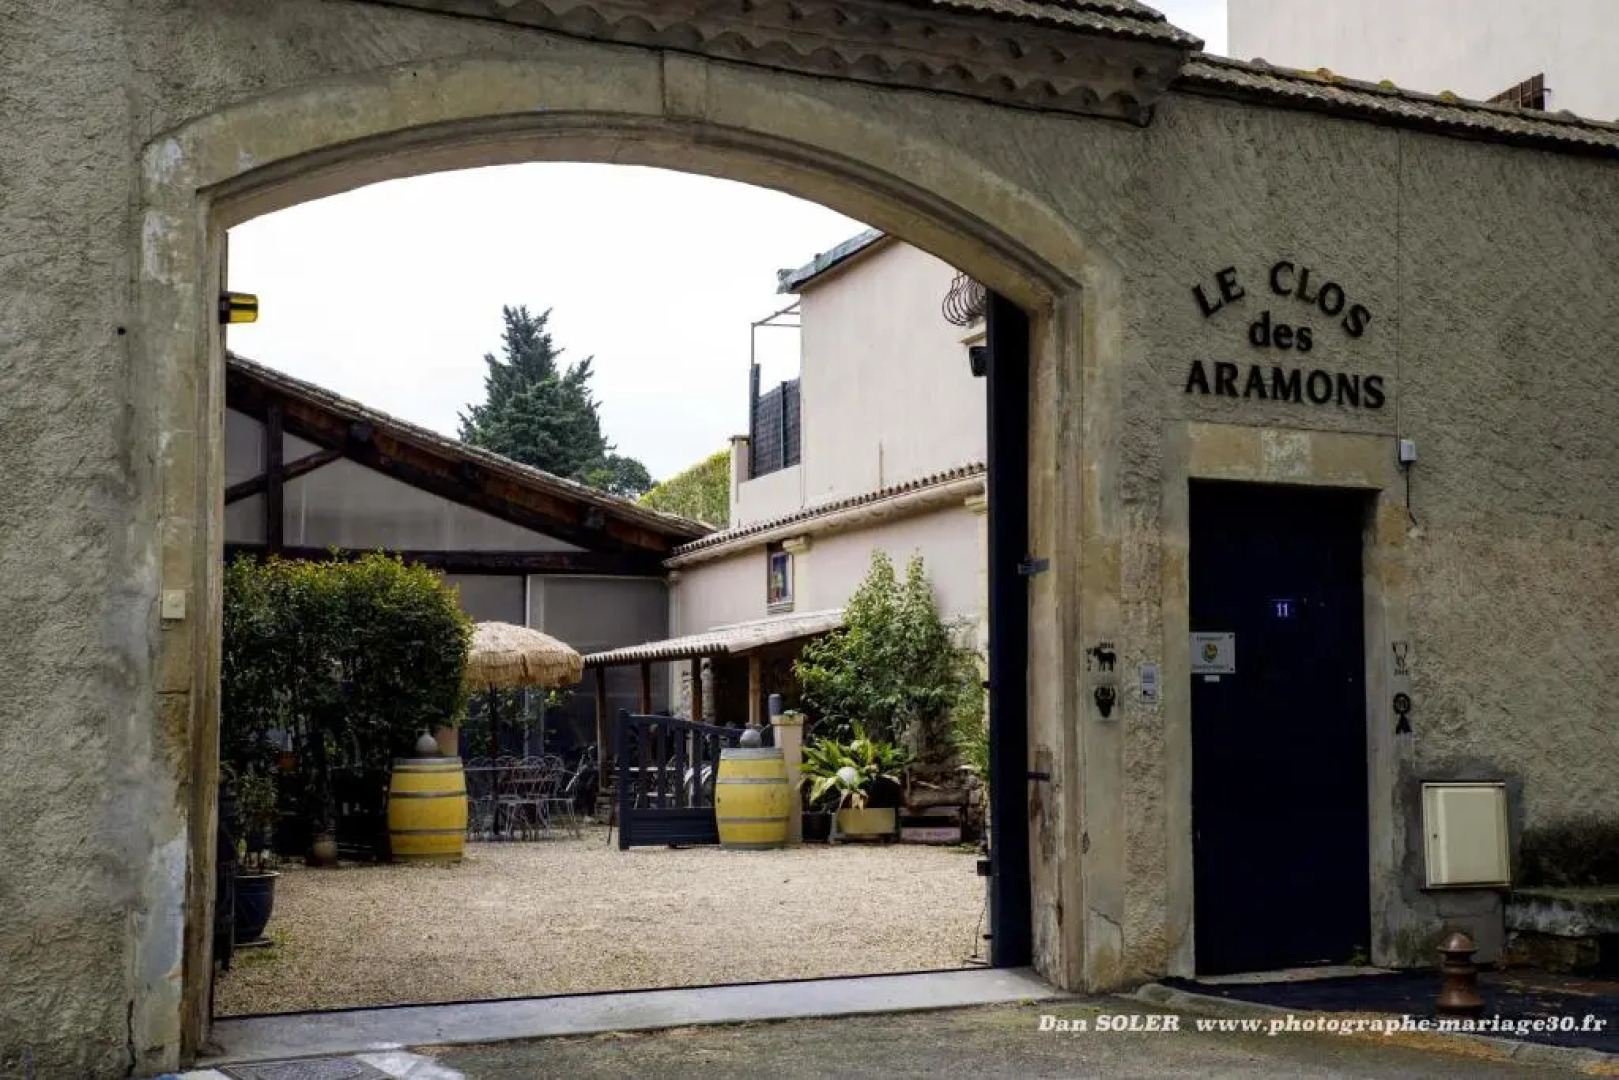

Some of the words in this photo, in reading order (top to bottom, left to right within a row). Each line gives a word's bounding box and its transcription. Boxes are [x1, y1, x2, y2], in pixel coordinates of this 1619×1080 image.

[1191, 265, 1245, 318] LE
[1270, 260, 1372, 338] CLOS
[1249, 310, 1313, 352] des
[1184, 359, 1386, 409] ARAMONS
[1276, 603, 1289, 618] 11
